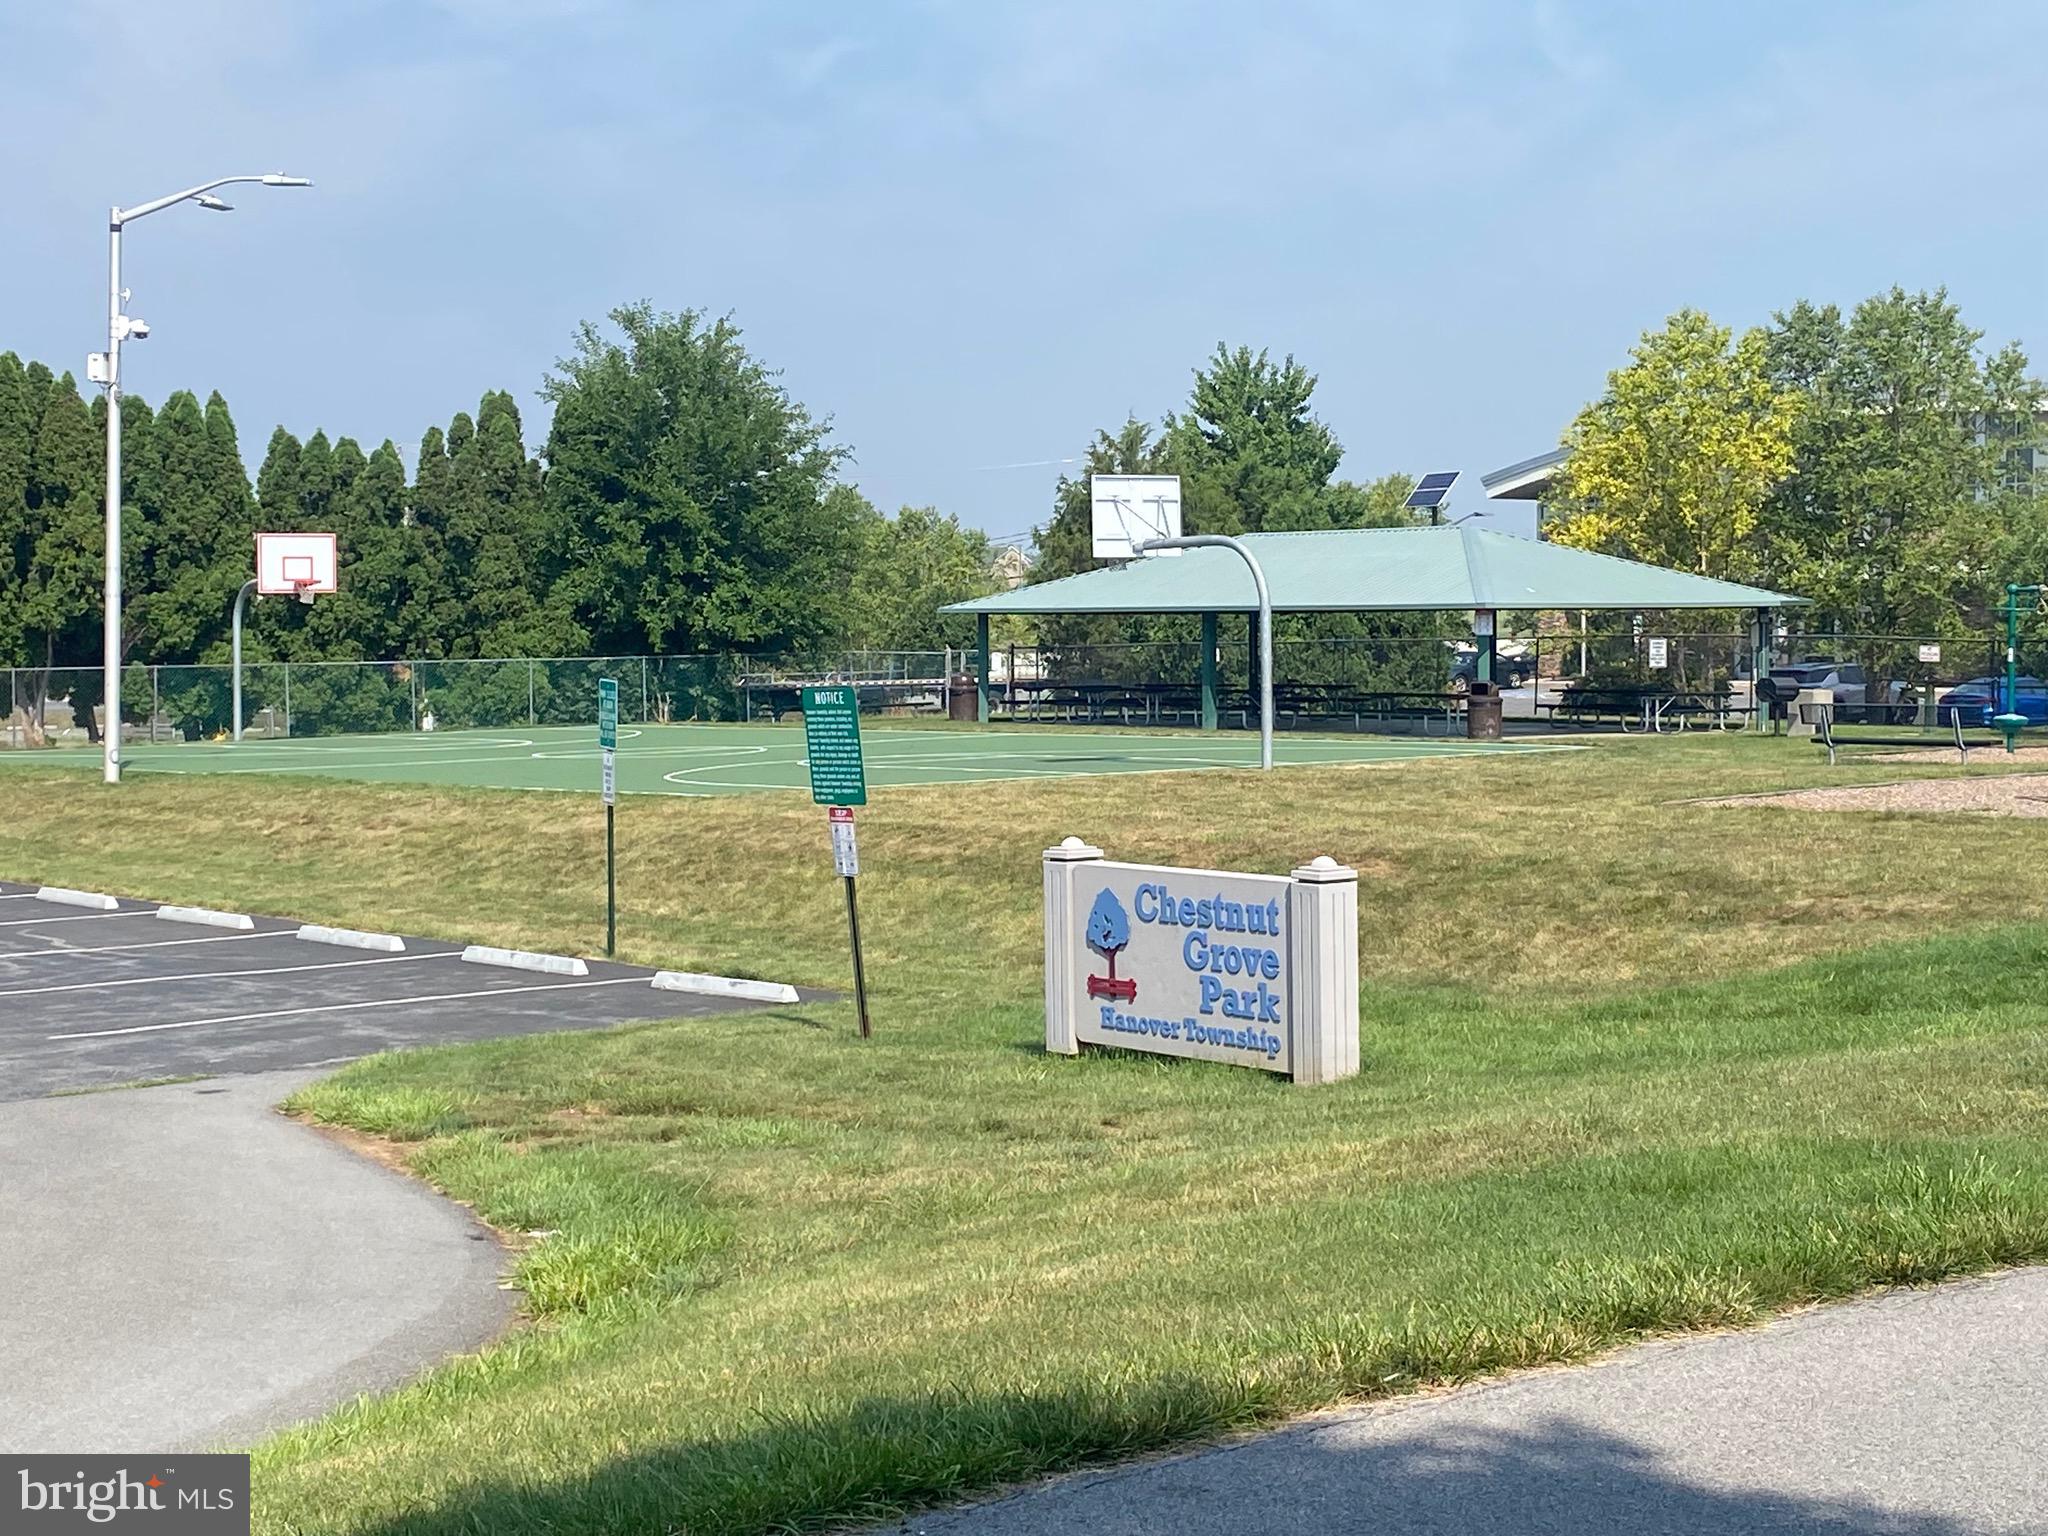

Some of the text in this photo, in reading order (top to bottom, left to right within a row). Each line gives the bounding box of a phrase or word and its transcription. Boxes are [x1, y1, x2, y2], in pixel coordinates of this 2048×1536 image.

[814, 691, 845, 705] NOTICE
[1134, 883, 1280, 936] Chestnut
[1183, 930, 1280, 980] Grove
[1199, 975, 1281, 1023] Park
[1100, 1006, 1281, 1060] Hanover Township
